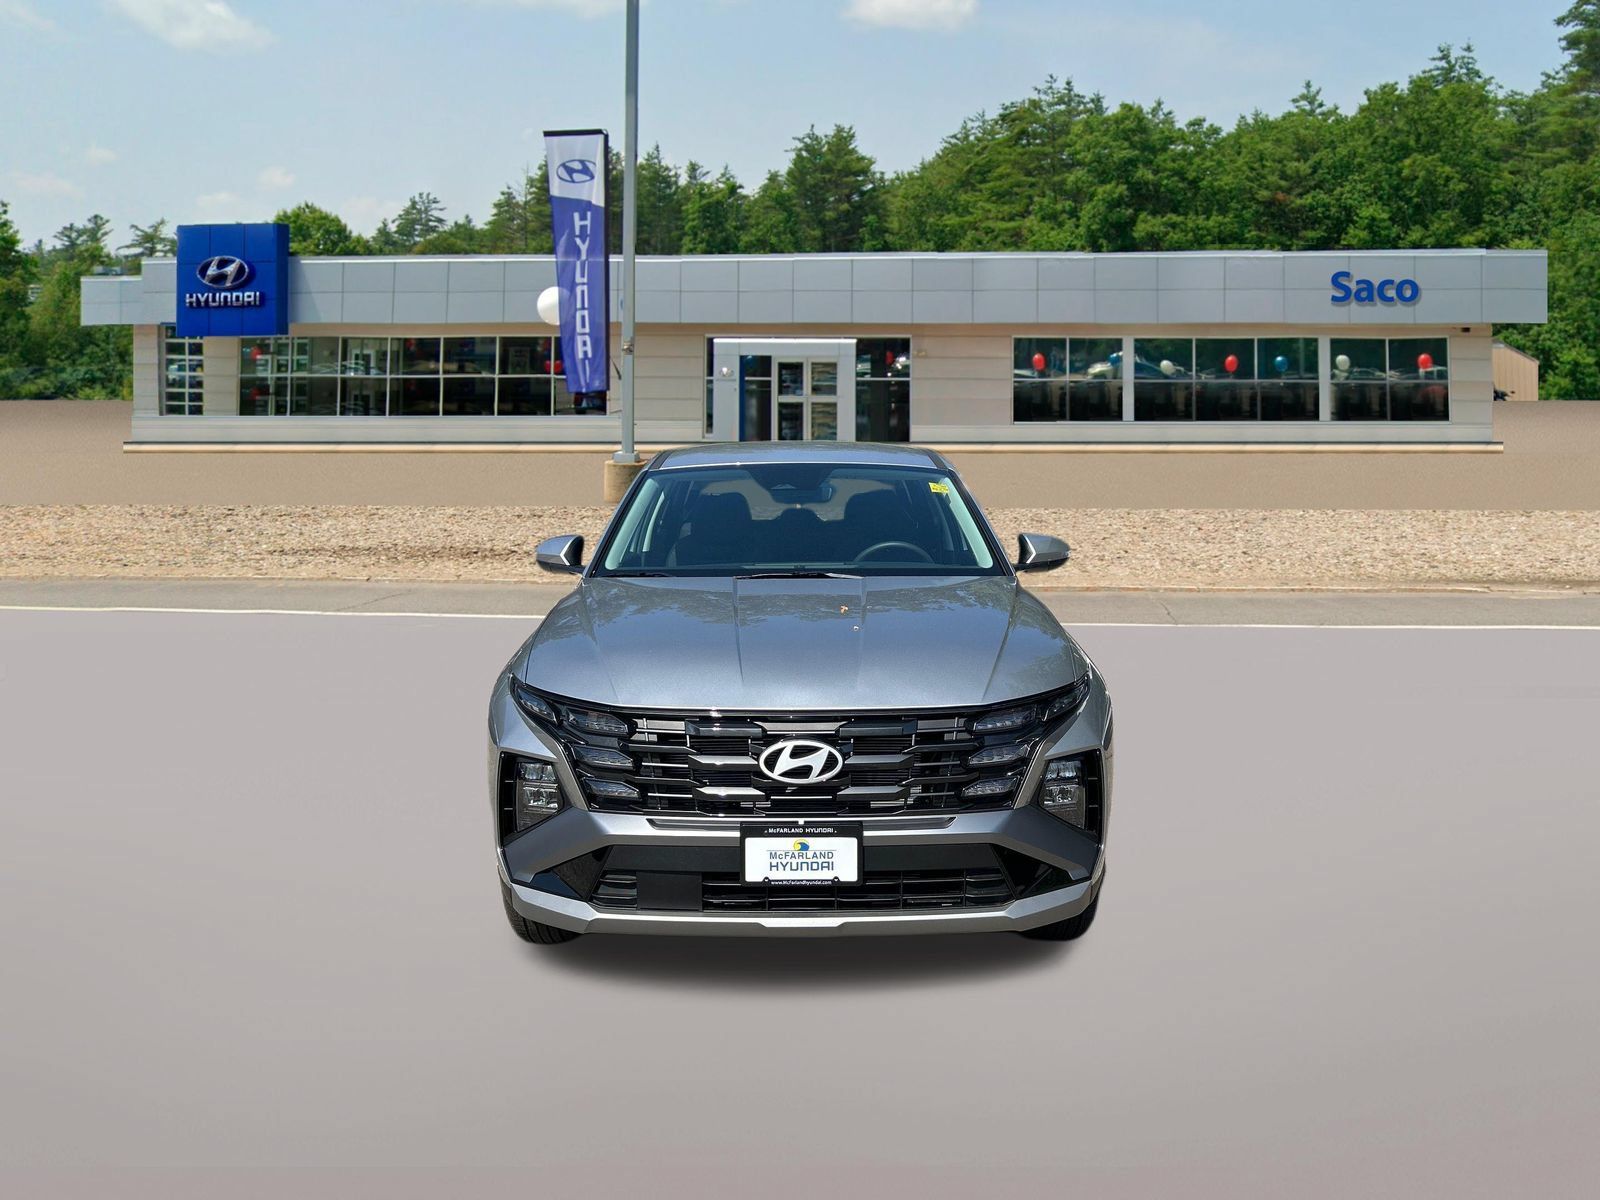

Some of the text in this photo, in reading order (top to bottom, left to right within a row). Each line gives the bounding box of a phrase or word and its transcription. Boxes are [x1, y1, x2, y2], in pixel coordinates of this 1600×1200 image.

[1330, 271, 1420, 303] Saco
[185, 291, 260, 307] HYUNDAI
[573, 211, 592, 384] HYUNDAI
[769, 851, 834, 860] McFARLAND
[769, 861, 834, 871] HYUNDAI
